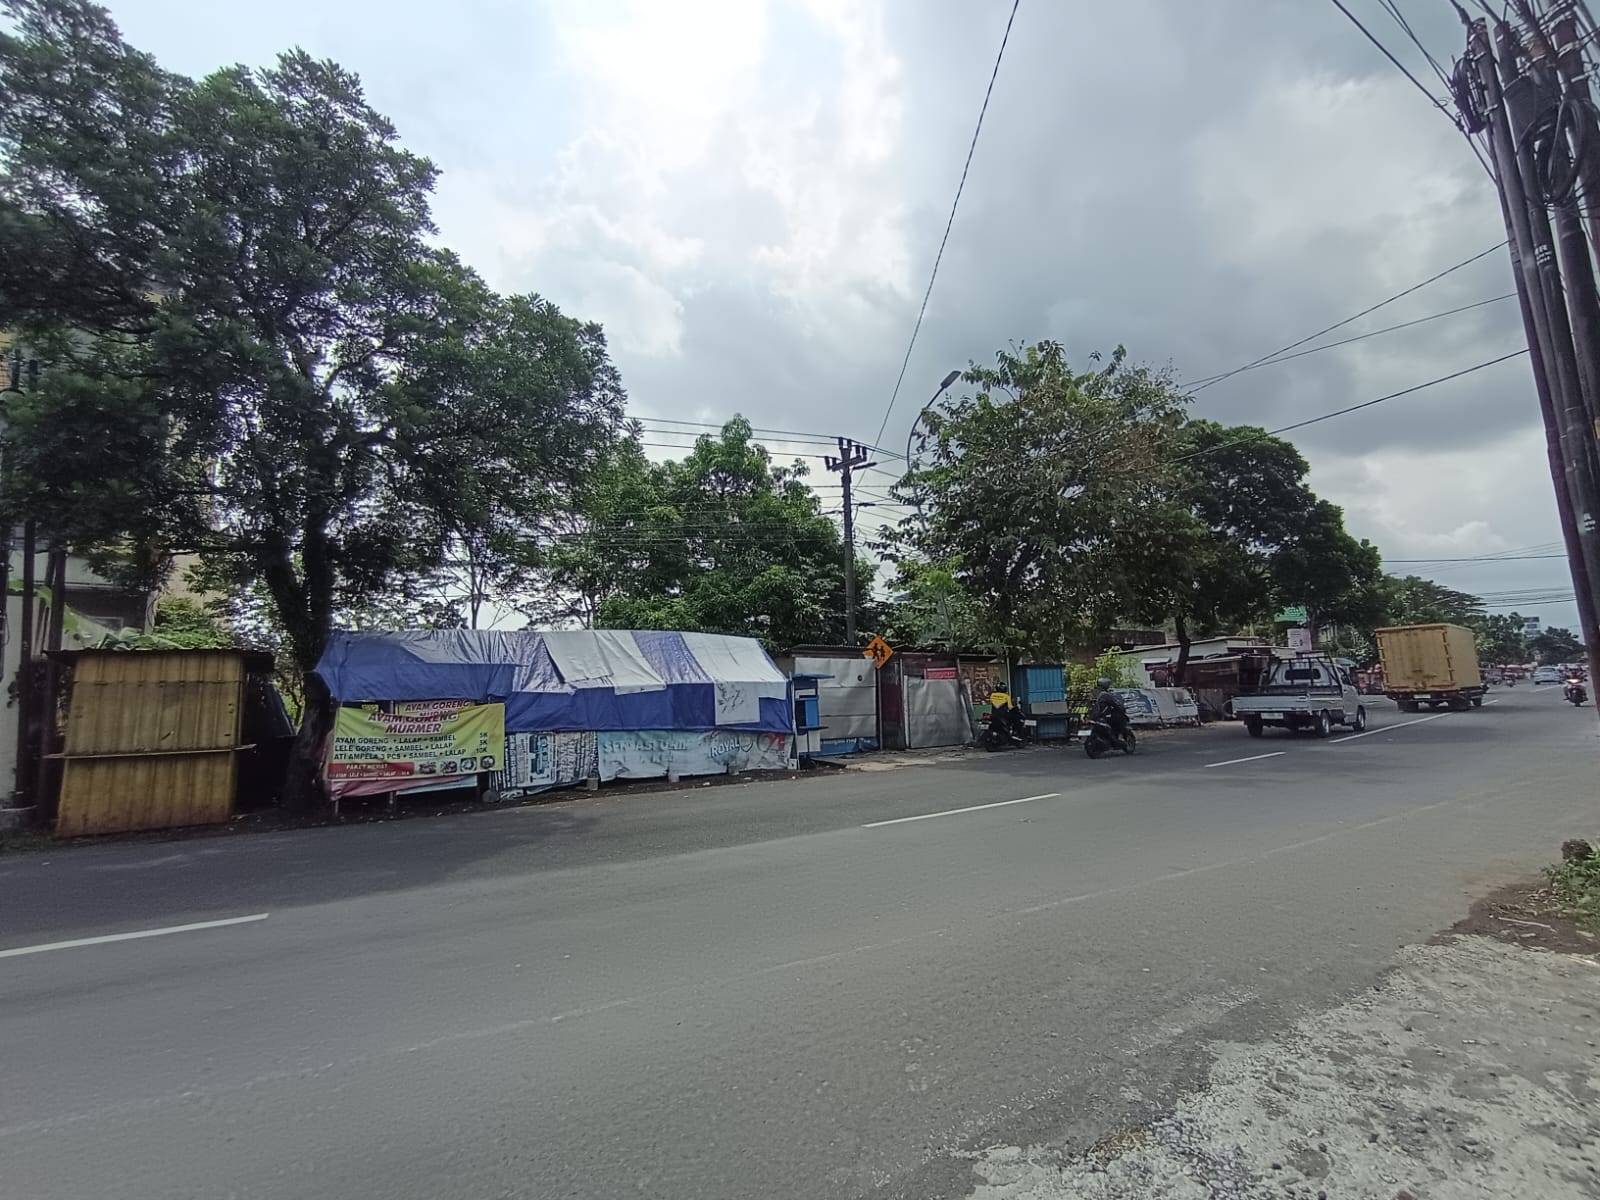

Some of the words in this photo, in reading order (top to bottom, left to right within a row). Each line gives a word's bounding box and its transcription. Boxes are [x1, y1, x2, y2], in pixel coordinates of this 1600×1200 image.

[405, 703, 431, 712] AYAM
[432, 700, 470, 710] GORENG
[368, 712, 402, 722] AYAM
[405, 712, 456, 722] GORENG
[386, 723, 441, 734] MURMER
[711, 736, 740, 758] ROYAL
